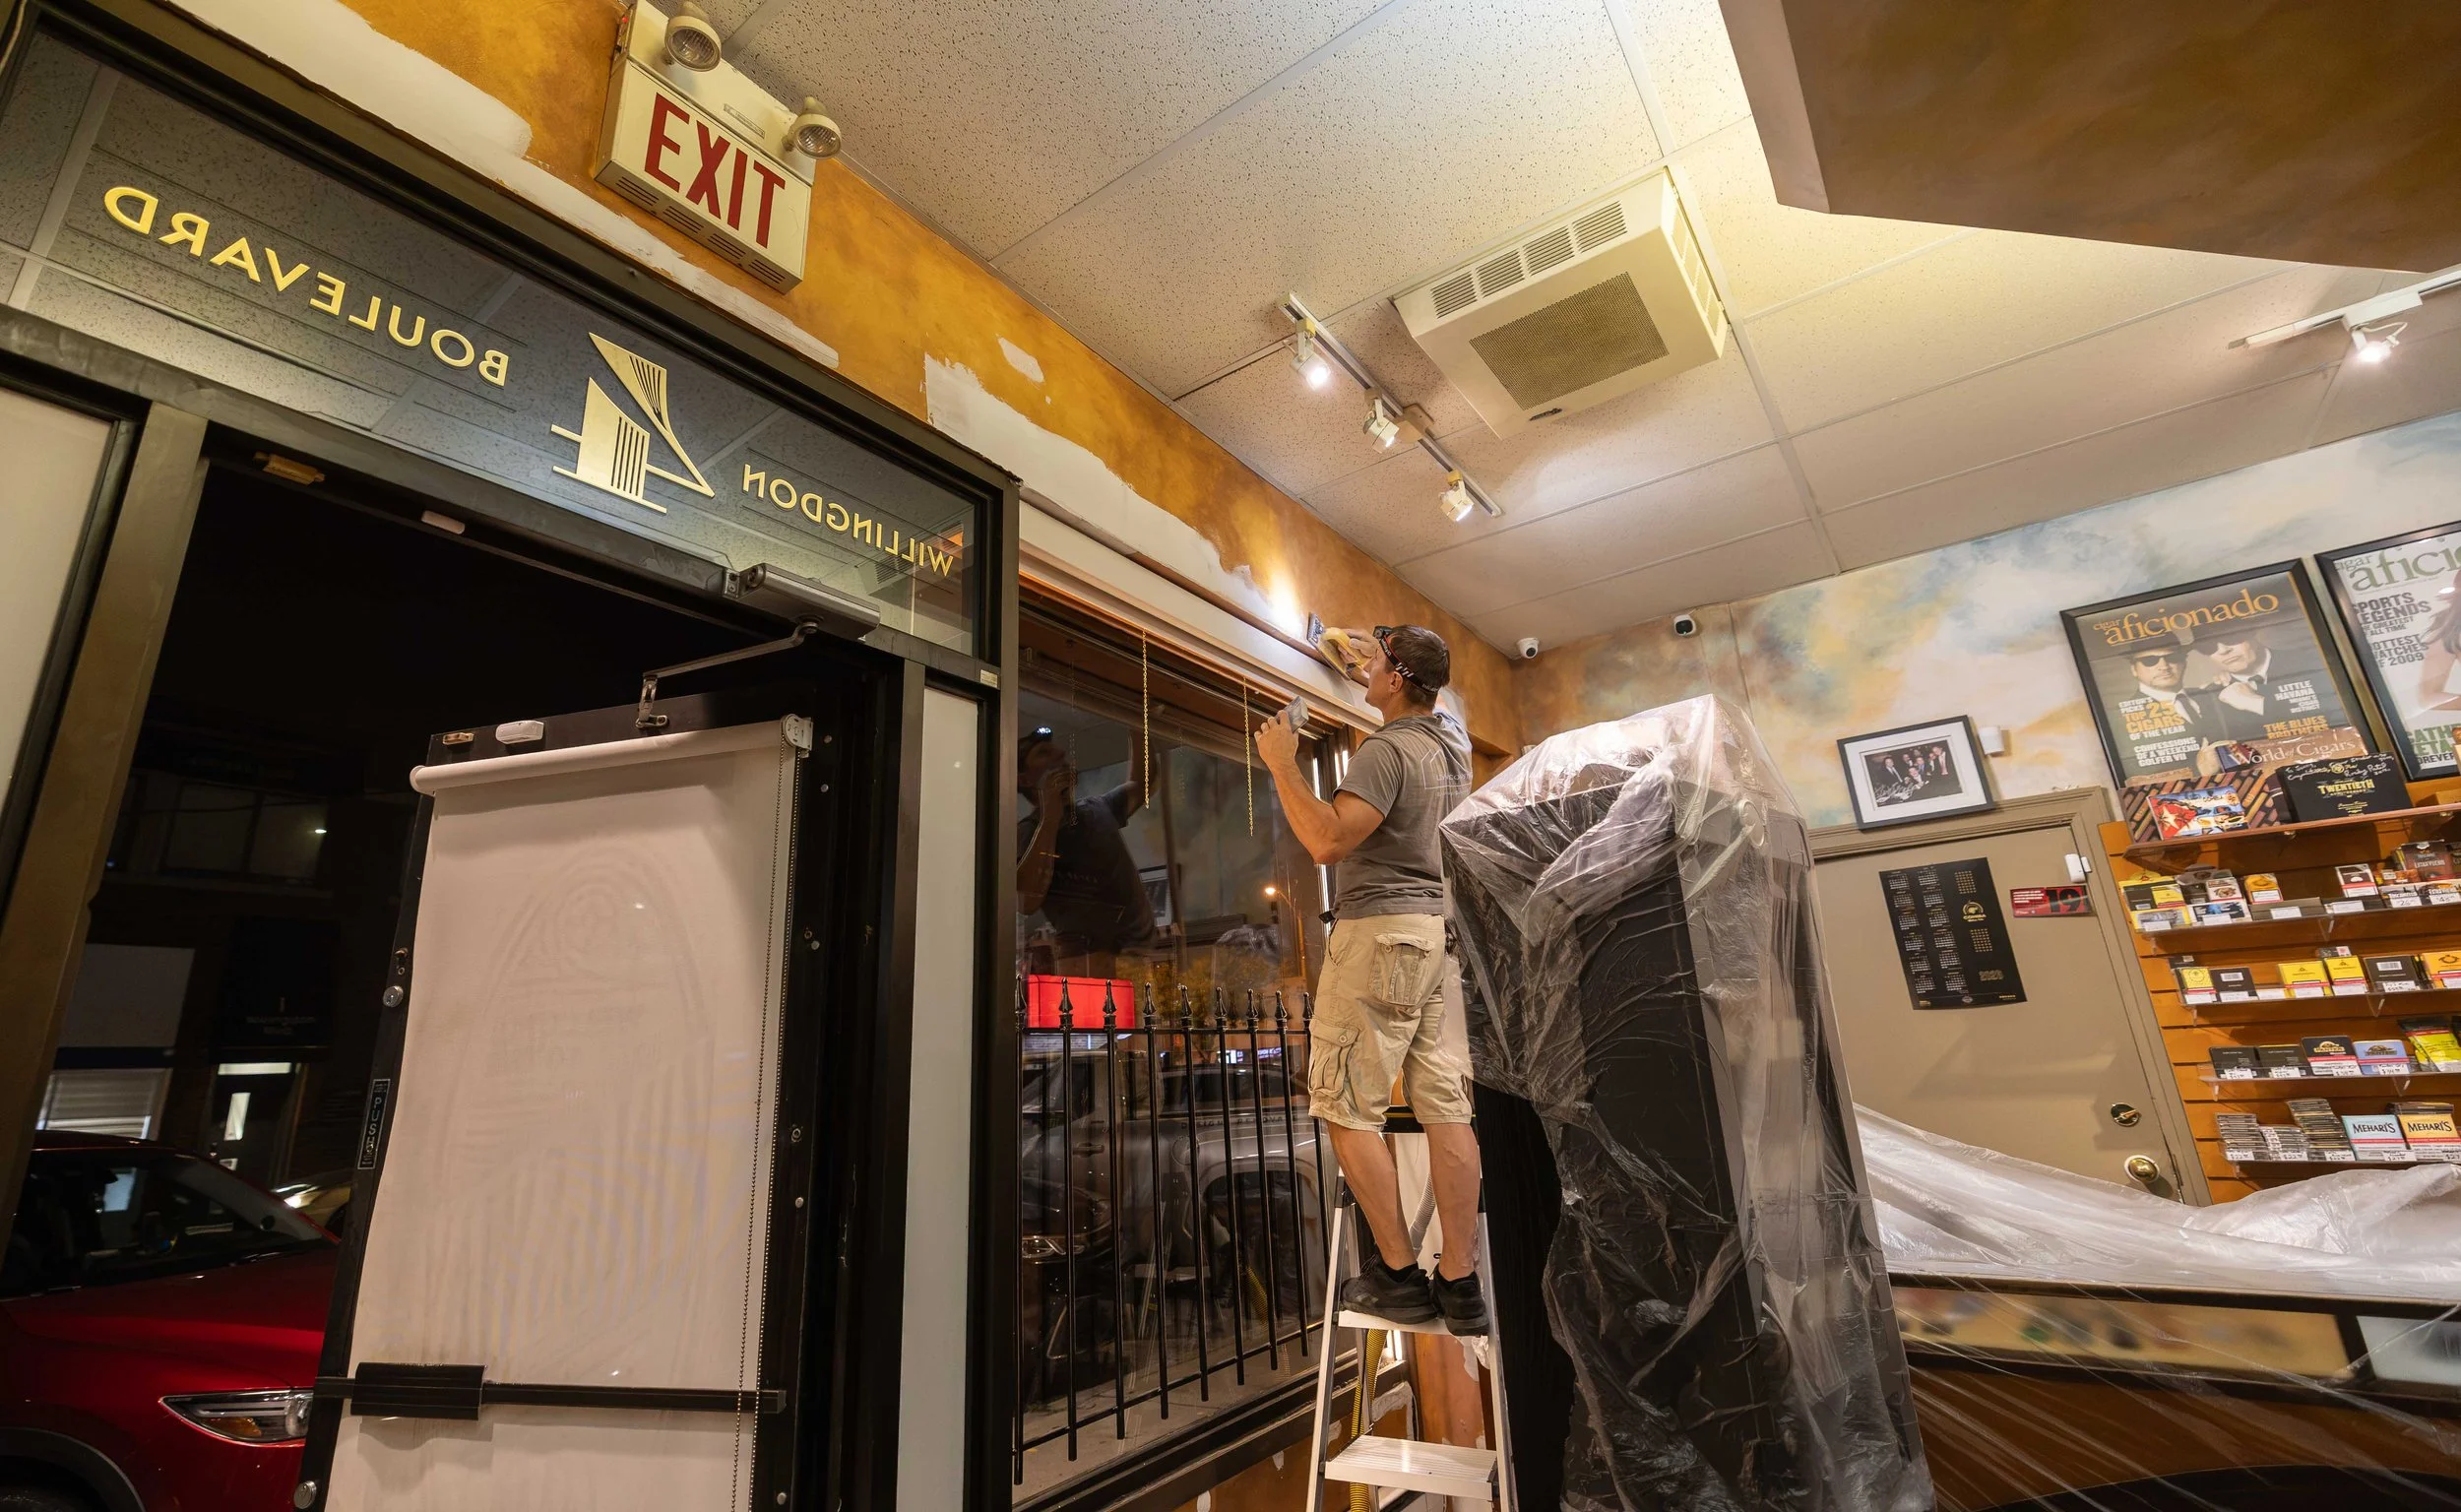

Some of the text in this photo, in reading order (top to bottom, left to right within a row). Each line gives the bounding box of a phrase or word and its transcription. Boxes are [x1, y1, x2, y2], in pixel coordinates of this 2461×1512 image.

[644, 92, 787, 249] EXIT
[2104, 588, 2280, 645] aficionado
[2358, 600, 2432, 625] EGENDS
[2388, 652, 2426, 666] 2009
[2274, 687, 2316, 701] HAVANA
[2277, 679, 2312, 693] LITTLE
[2125, 700, 2176, 723] TOP 25
[2126, 714, 2186, 734] CIGARS
[2263, 715, 2327, 733] THE BLUES
[2129, 732, 2141, 741] OF
[2143, 728, 2161, 738] THE
[2133, 736, 2197, 753] CONFESSIONS
[2156, 743, 2201, 757] WEEKEND
[2228, 746, 2286, 765] World
[2296, 740, 2357, 758] Cigars
[2138, 755, 2174, 768] GOLFER
[2317, 779, 2375, 794] TWENTIETH
[365, 1097, 382, 1151] PUSH
[2353, 1122, 2396, 1134] MEHARI'S
[2407, 1120, 2452, 1133] MEHARI'S
